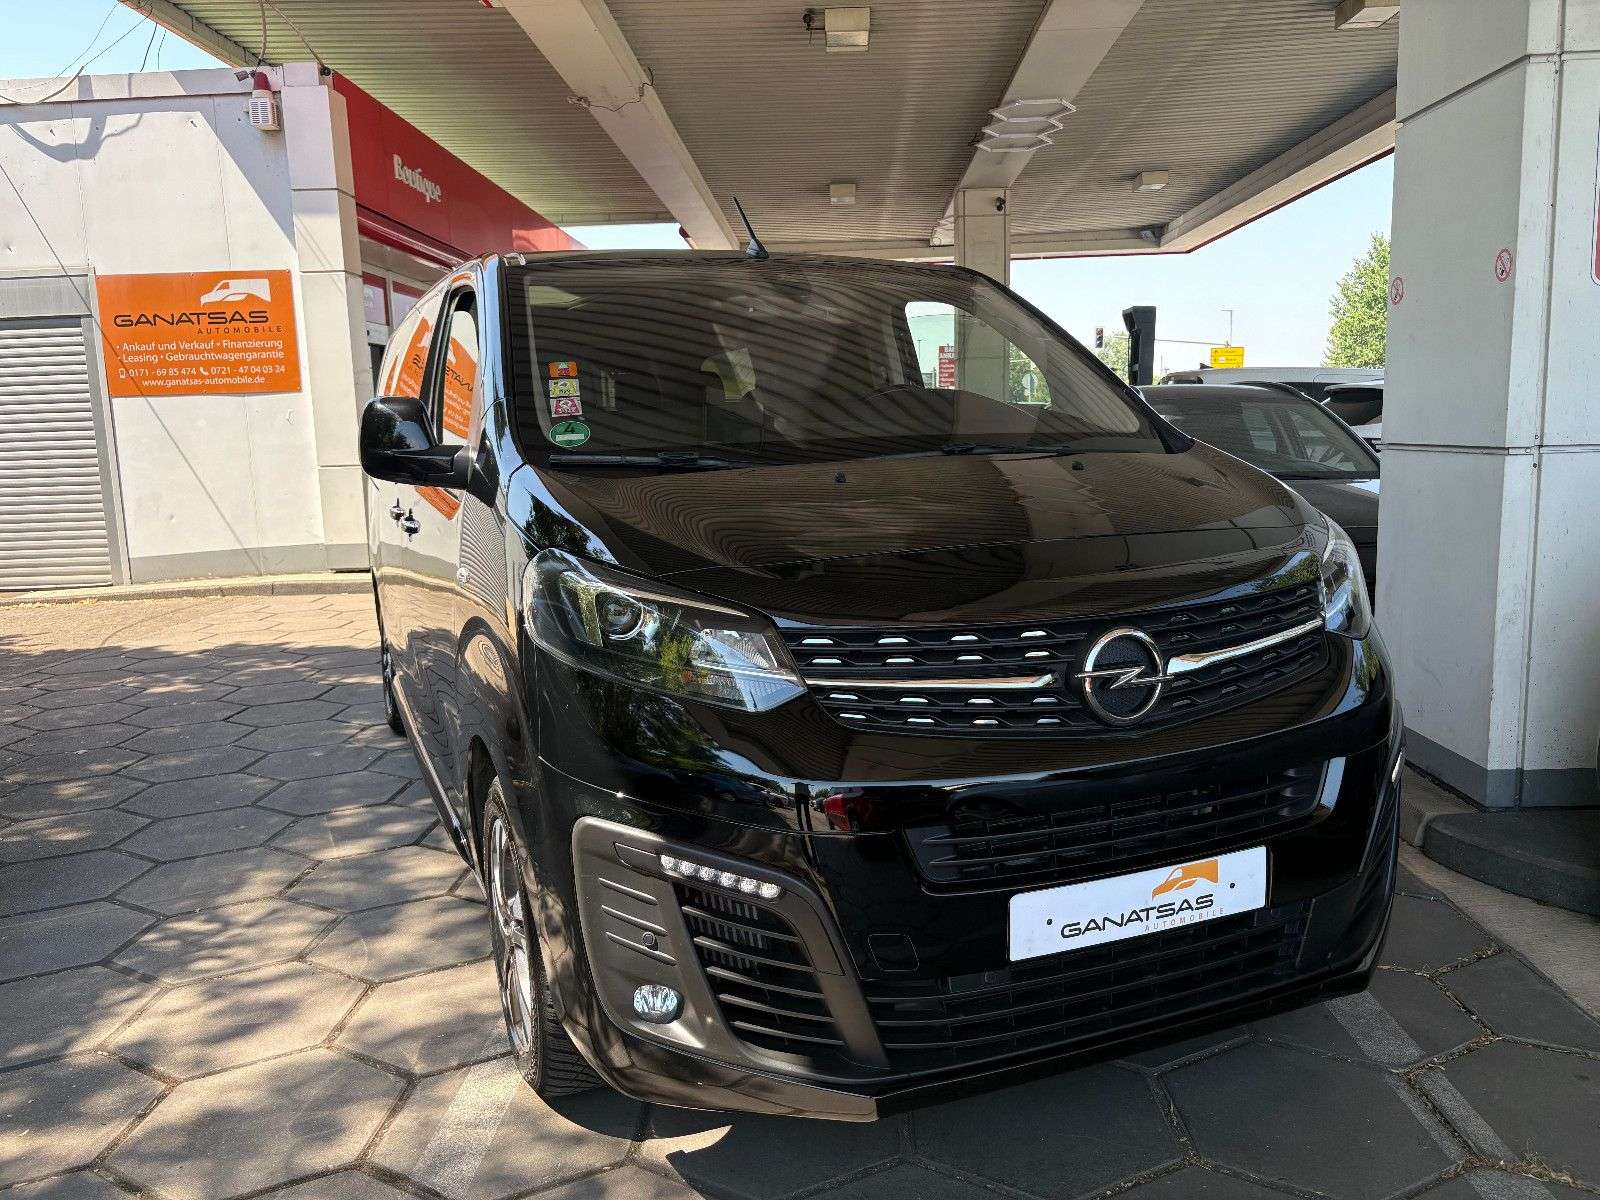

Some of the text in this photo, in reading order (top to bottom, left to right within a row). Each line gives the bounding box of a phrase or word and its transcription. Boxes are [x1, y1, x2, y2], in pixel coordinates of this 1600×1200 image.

[392, 153, 441, 202] Boutique
[113, 310, 269, 328] GANATSAS
[197, 325, 282, 335] AUTOMOBILE
[122, 339, 283, 352] Ankauf und Verkauf Finanzierung
[122, 350, 284, 364] Leasing Gebrauchtwagengarantie
[129, 367, 149, 377] 0171
[210, 366, 231, 375] 0721
[142, 374, 265, 388] www.ganatsas-automobile.de
[564, 422, 575, 433] 4
[1060, 893, 1214, 939] GANATSAS
[1144, 907, 1225, 932] AUTOMOBILE
